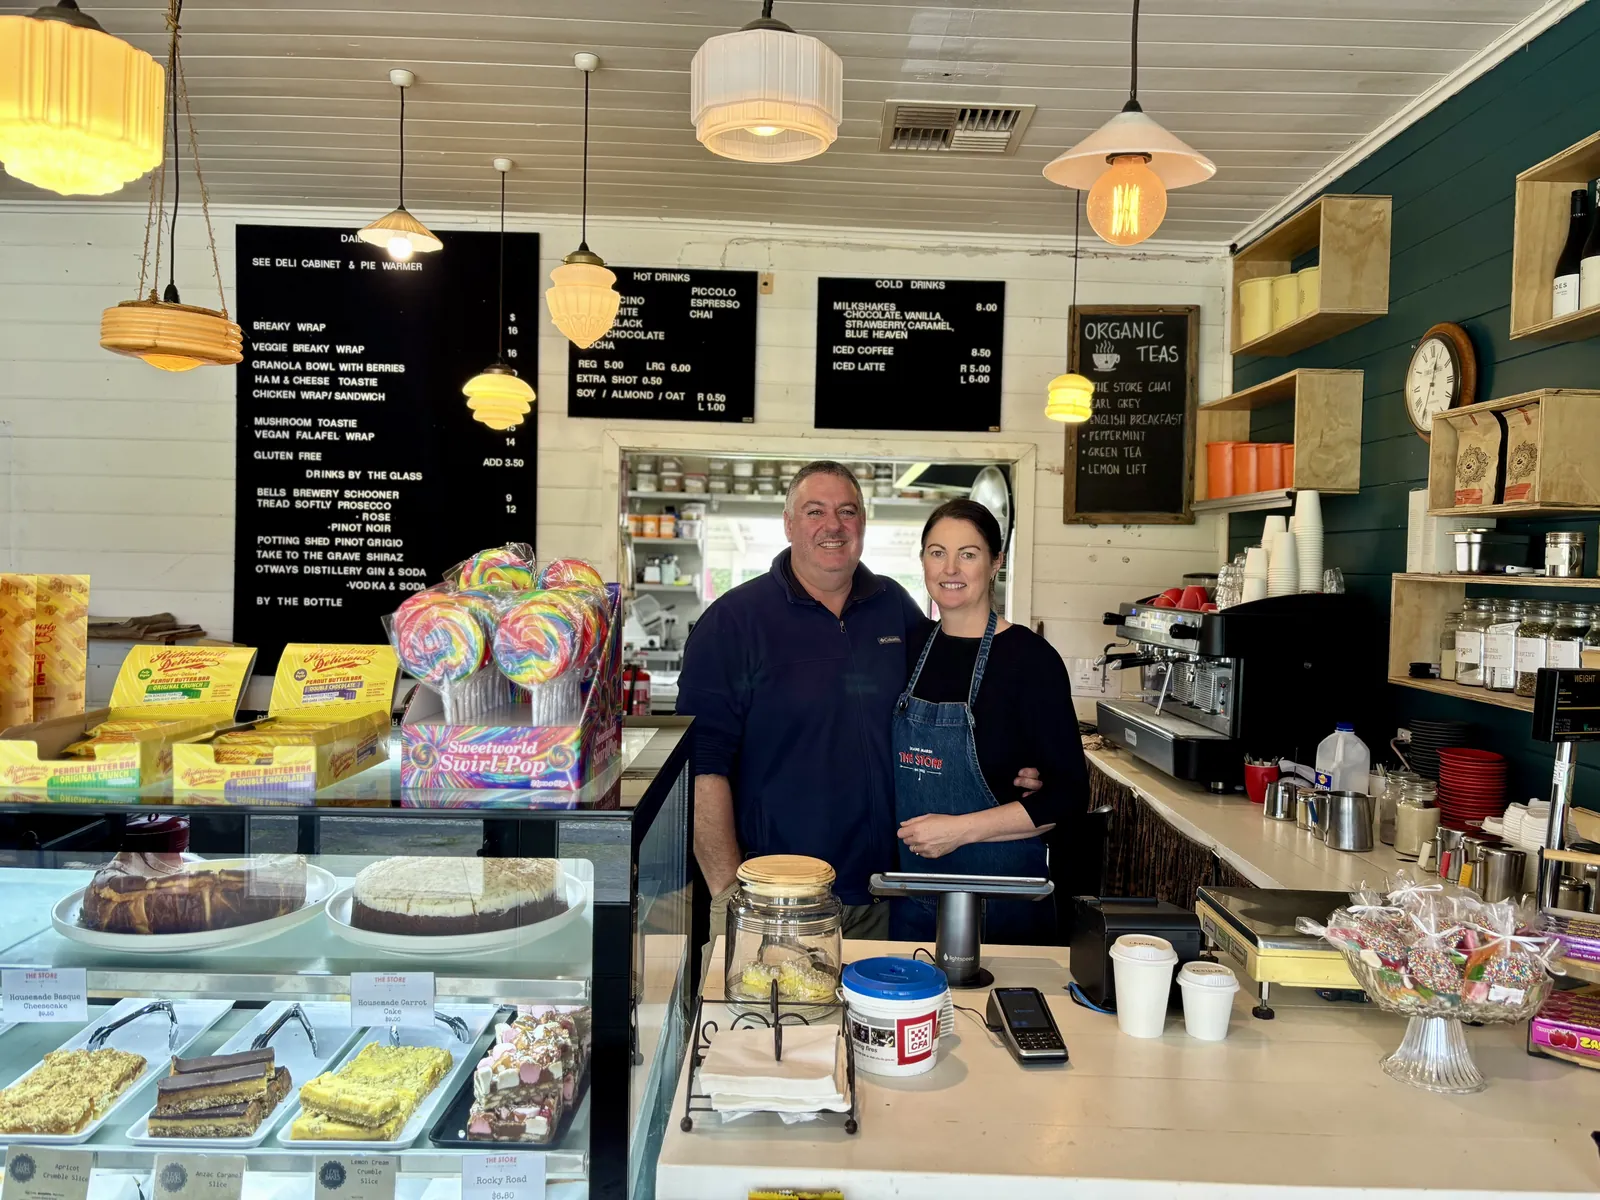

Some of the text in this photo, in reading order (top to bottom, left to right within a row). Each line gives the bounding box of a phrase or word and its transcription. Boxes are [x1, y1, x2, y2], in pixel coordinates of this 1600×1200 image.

[253, 258, 422, 270] SEE DELI CABINET PIE WARMER
[634, 272, 690, 282] HOT DRINKS
[876, 280, 945, 289] COLD DRINKS
[692, 287, 736, 296] PICCOLO
[691, 299, 740, 308] ESPRESSO
[834, 302, 997, 313] MILKSHAKES 8.00
[690, 310, 712, 318] CHAI
[904, 312, 944, 322] VANILLA,
[253, 322, 290, 330] BREAKY
[297, 323, 326, 331] WRAP
[845, 320, 954, 331] STRAWBERRY, CARAMEL,
[1085, 322, 1163, 340] ORGANIC
[606, 330, 664, 340] CHOCOLATE
[846, 329, 908, 339] BLUE HEAVEN
[252, 343, 517, 357] VEGGIE BREAKY WRAP 16
[833, 346, 991, 357] ICED COFFEE 8.50
[1136, 346, 1178, 362] TEAS
[252, 360, 405, 372] GRANOLA BOWL WITH BERRIES
[579, 360, 691, 372] REG 5.00 LRG 6.00
[833, 362, 990, 373] ICED LATTE 5.00
[255, 375, 377, 386] HAM CHEESE TOASTIE
[577, 374, 662, 385] EXTRA SHOT 0.50
[1092, 381, 1170, 393] THE STORE CHAI
[253, 390, 385, 401] CHICKEN SANDWICH
[577, 389, 726, 402] SOY ALMOND OAT 0.50
[1091, 398, 1140, 408] EARL GREY
[255, 417, 357, 427] MUSHROOM TOASTIE
[1090, 414, 1182, 426] ENGLISH BREAKFAST
[255, 430, 375, 440] VEGAN FALAFEL WRAP
[1089, 430, 1146, 442] PEPPERMINT
[1088, 447, 1142, 458] GREEN TEA
[254, 451, 524, 467] GLUTEN FREE ADD 3.50
[1089, 464, 1147, 474] LEMON LIFT
[306, 470, 422, 480] DRINKS BY THE GLASS
[257, 488, 399, 499] BELLS BREWERY SCHOONER
[257, 499, 516, 513] TREAD SOFTLY PROSECCO 12
[258, 536, 403, 547] POTTING SHED PINOT GRIGIO
[256, 550, 403, 561] TAKE TO THE GRAVE SHIRAZ
[256, 565, 426, 576] OTWAYS DISTILLERY GIN SODA
[257, 597, 342, 606] BY THE BOTTLE
[150, 649, 228, 663] Ridiculously
[158, 655, 216, 671] Delicious
[312, 655, 367, 672] Delicious
[1574, 674, 1596, 682] WEIGHT
[329, 682, 356, 690] CHOCOLATE
[448, 740, 538, 754] Sweetworld
[899, 752, 942, 770] THE STORE
[230, 767, 294, 778] PEANUT BUTTER
[60, 774, 95, 783] ORIGINAL
[236, 774, 304, 786] DOUBLE CHOCOLATE
[949, 954, 975, 962] lightspeed
[54, 994, 80, 1002] Basque
[24, 1002, 68, 1010] Cheesecake
[911, 1039, 928, 1051] CFA
[486, 1156, 517, 1164] THE STORE
[54, 1164, 80, 1172] Apricot
[357, 1168, 382, 1176] Crumble
[43, 1172, 68, 1181] Crumble
[476, 1176, 528, 1188] Rocky Road
